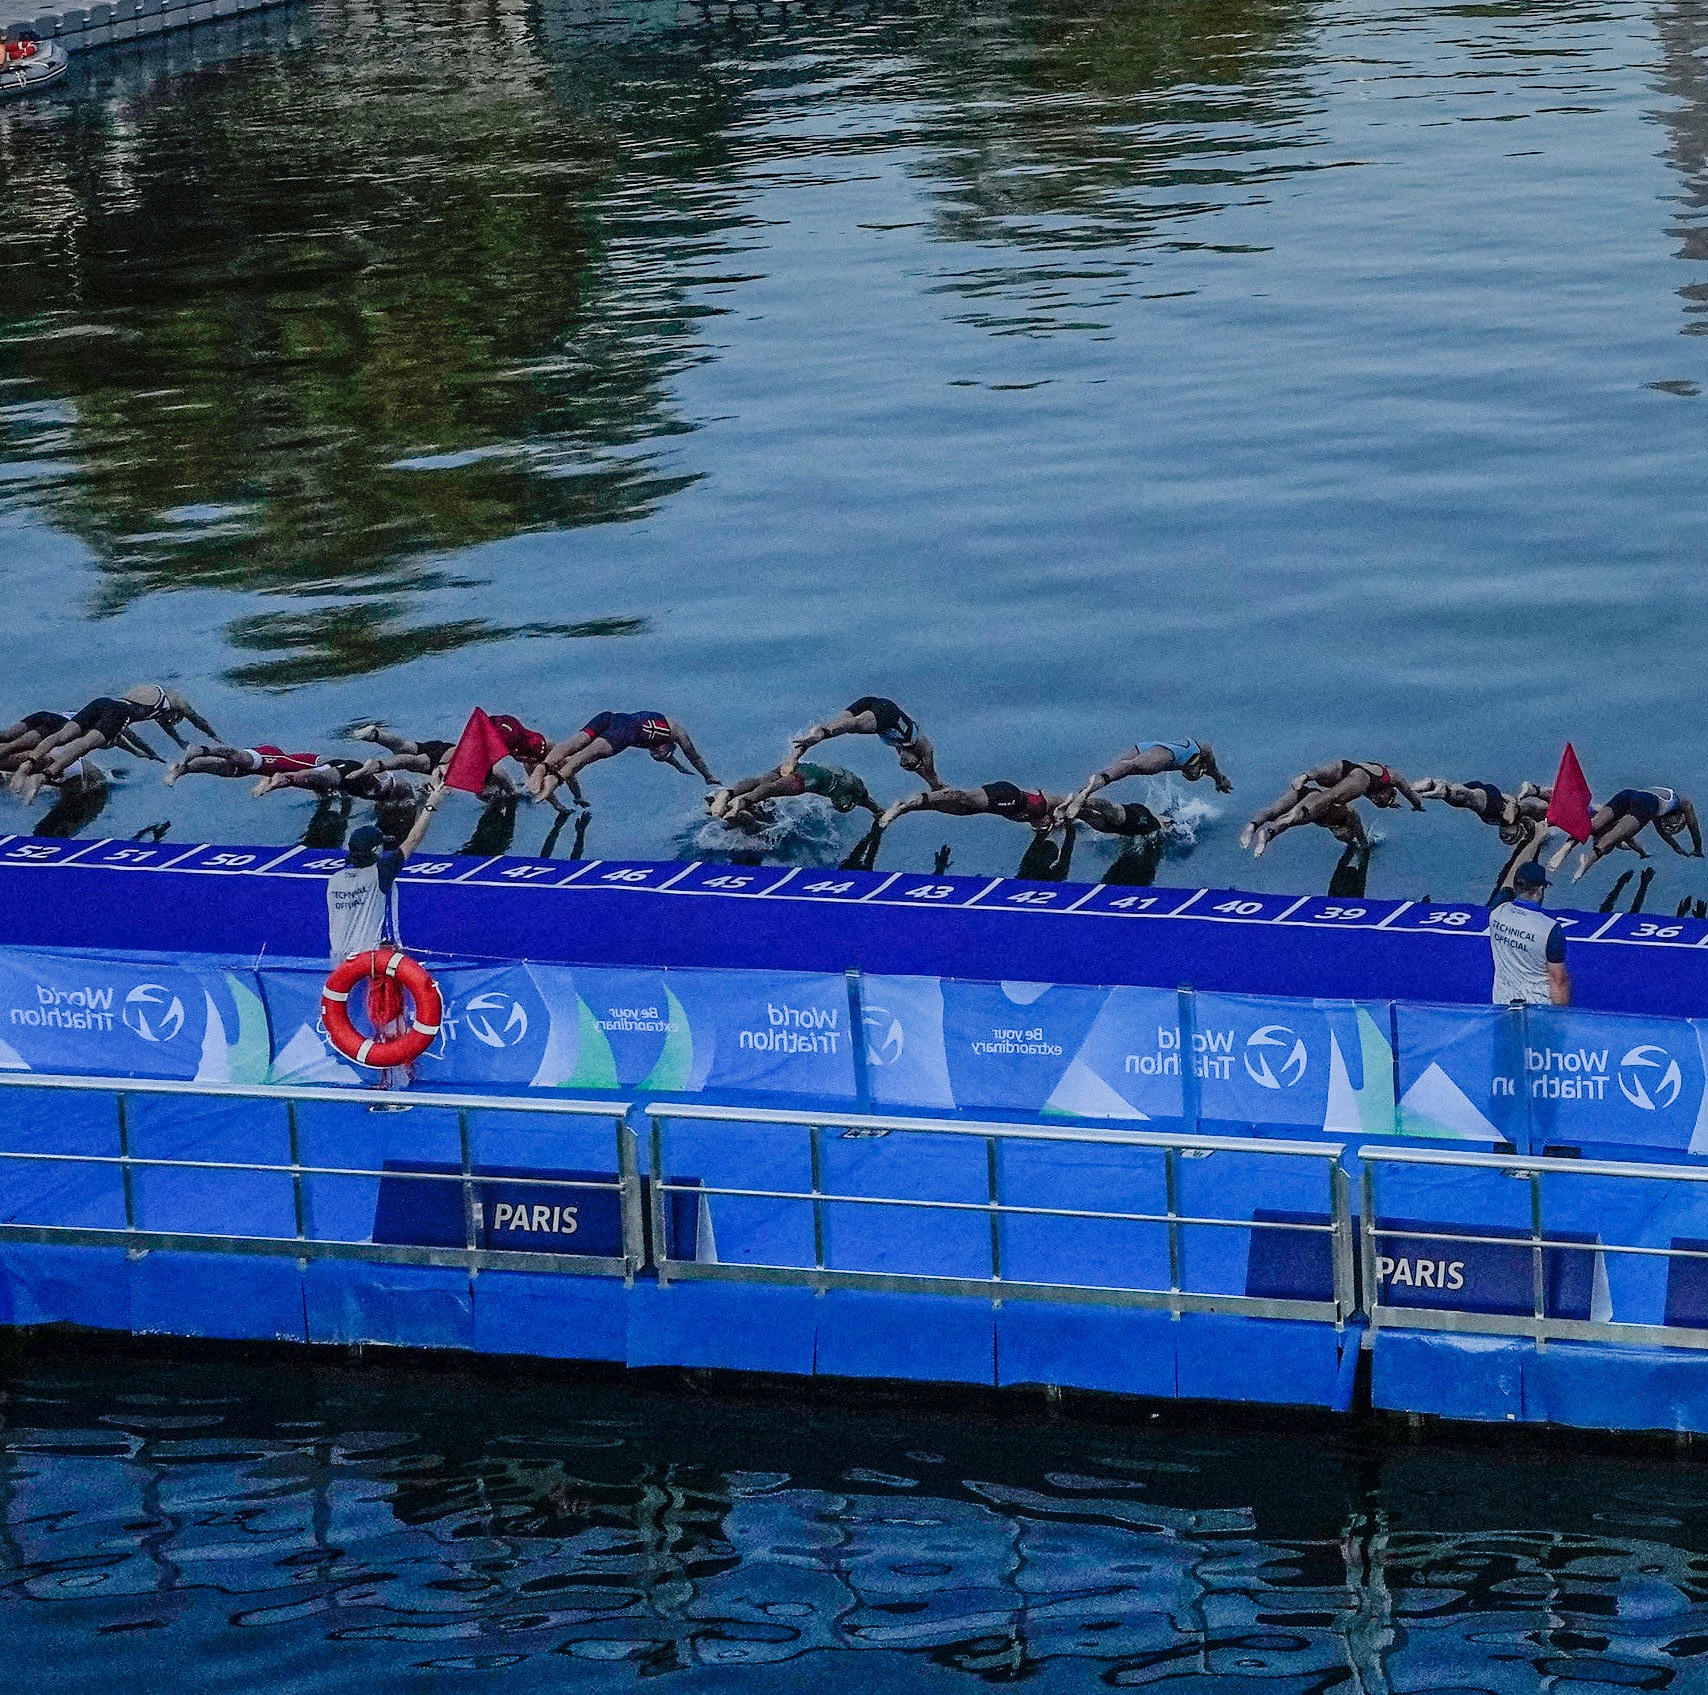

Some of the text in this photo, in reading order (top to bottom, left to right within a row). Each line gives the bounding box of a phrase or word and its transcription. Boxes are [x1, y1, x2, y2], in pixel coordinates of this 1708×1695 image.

[6, 844, 62, 860] 52
[104, 849, 157, 863] 51
[202, 853, 256, 867] 50
[402, 861, 453, 875] 48
[501, 866, 556, 879] 47
[601, 869, 654, 882] 46
[701, 876, 755, 888] 45
[803, 881, 855, 894] 44
[905, 885, 955, 899] 43
[1007, 891, 1058, 904] 42
[1109, 896, 1159, 910] 41
[1213, 901, 1263, 915] 40
[1315, 906, 1367, 921] 39
[1419, 911, 1471, 926] 38
[1556, 916, 1579, 929] 7
[1493, 919, 1536, 942] TECHNICAL
[1630, 924, 1683, 938] 36
[1494, 933, 1529, 952] OFFICIAL
[494, 1203, 578, 1234] PARIS
[1376, 1256, 1465, 1290] PARIS
